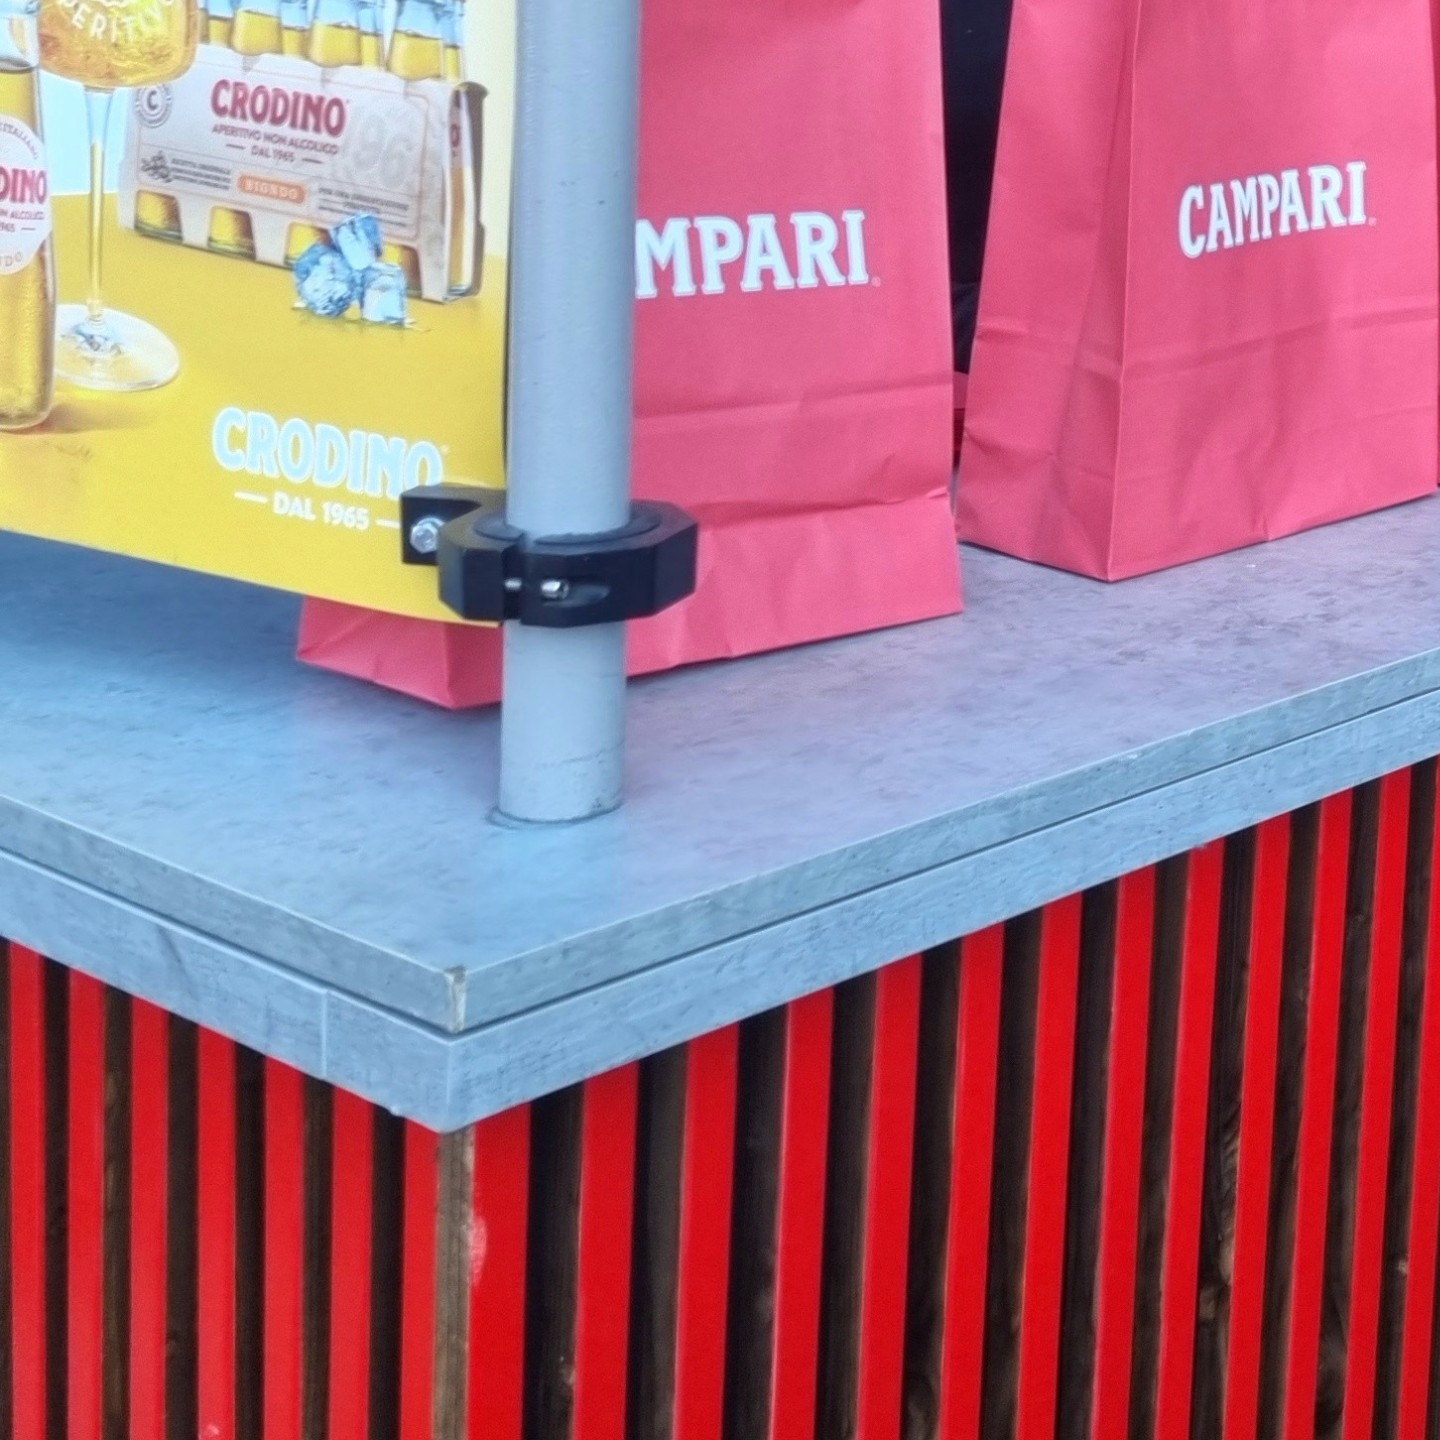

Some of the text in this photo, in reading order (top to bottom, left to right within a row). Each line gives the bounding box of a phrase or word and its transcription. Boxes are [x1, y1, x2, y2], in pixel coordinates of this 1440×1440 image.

[210, 79, 346, 138] CRODINO
[0, 165, 47, 205] DINO
[1178, 160, 1368, 259] CAMPARI
[634, 209, 870, 300] MPARI
[212, 406, 443, 501] CRODINO
[272, 491, 370, 530] DAL 1965
